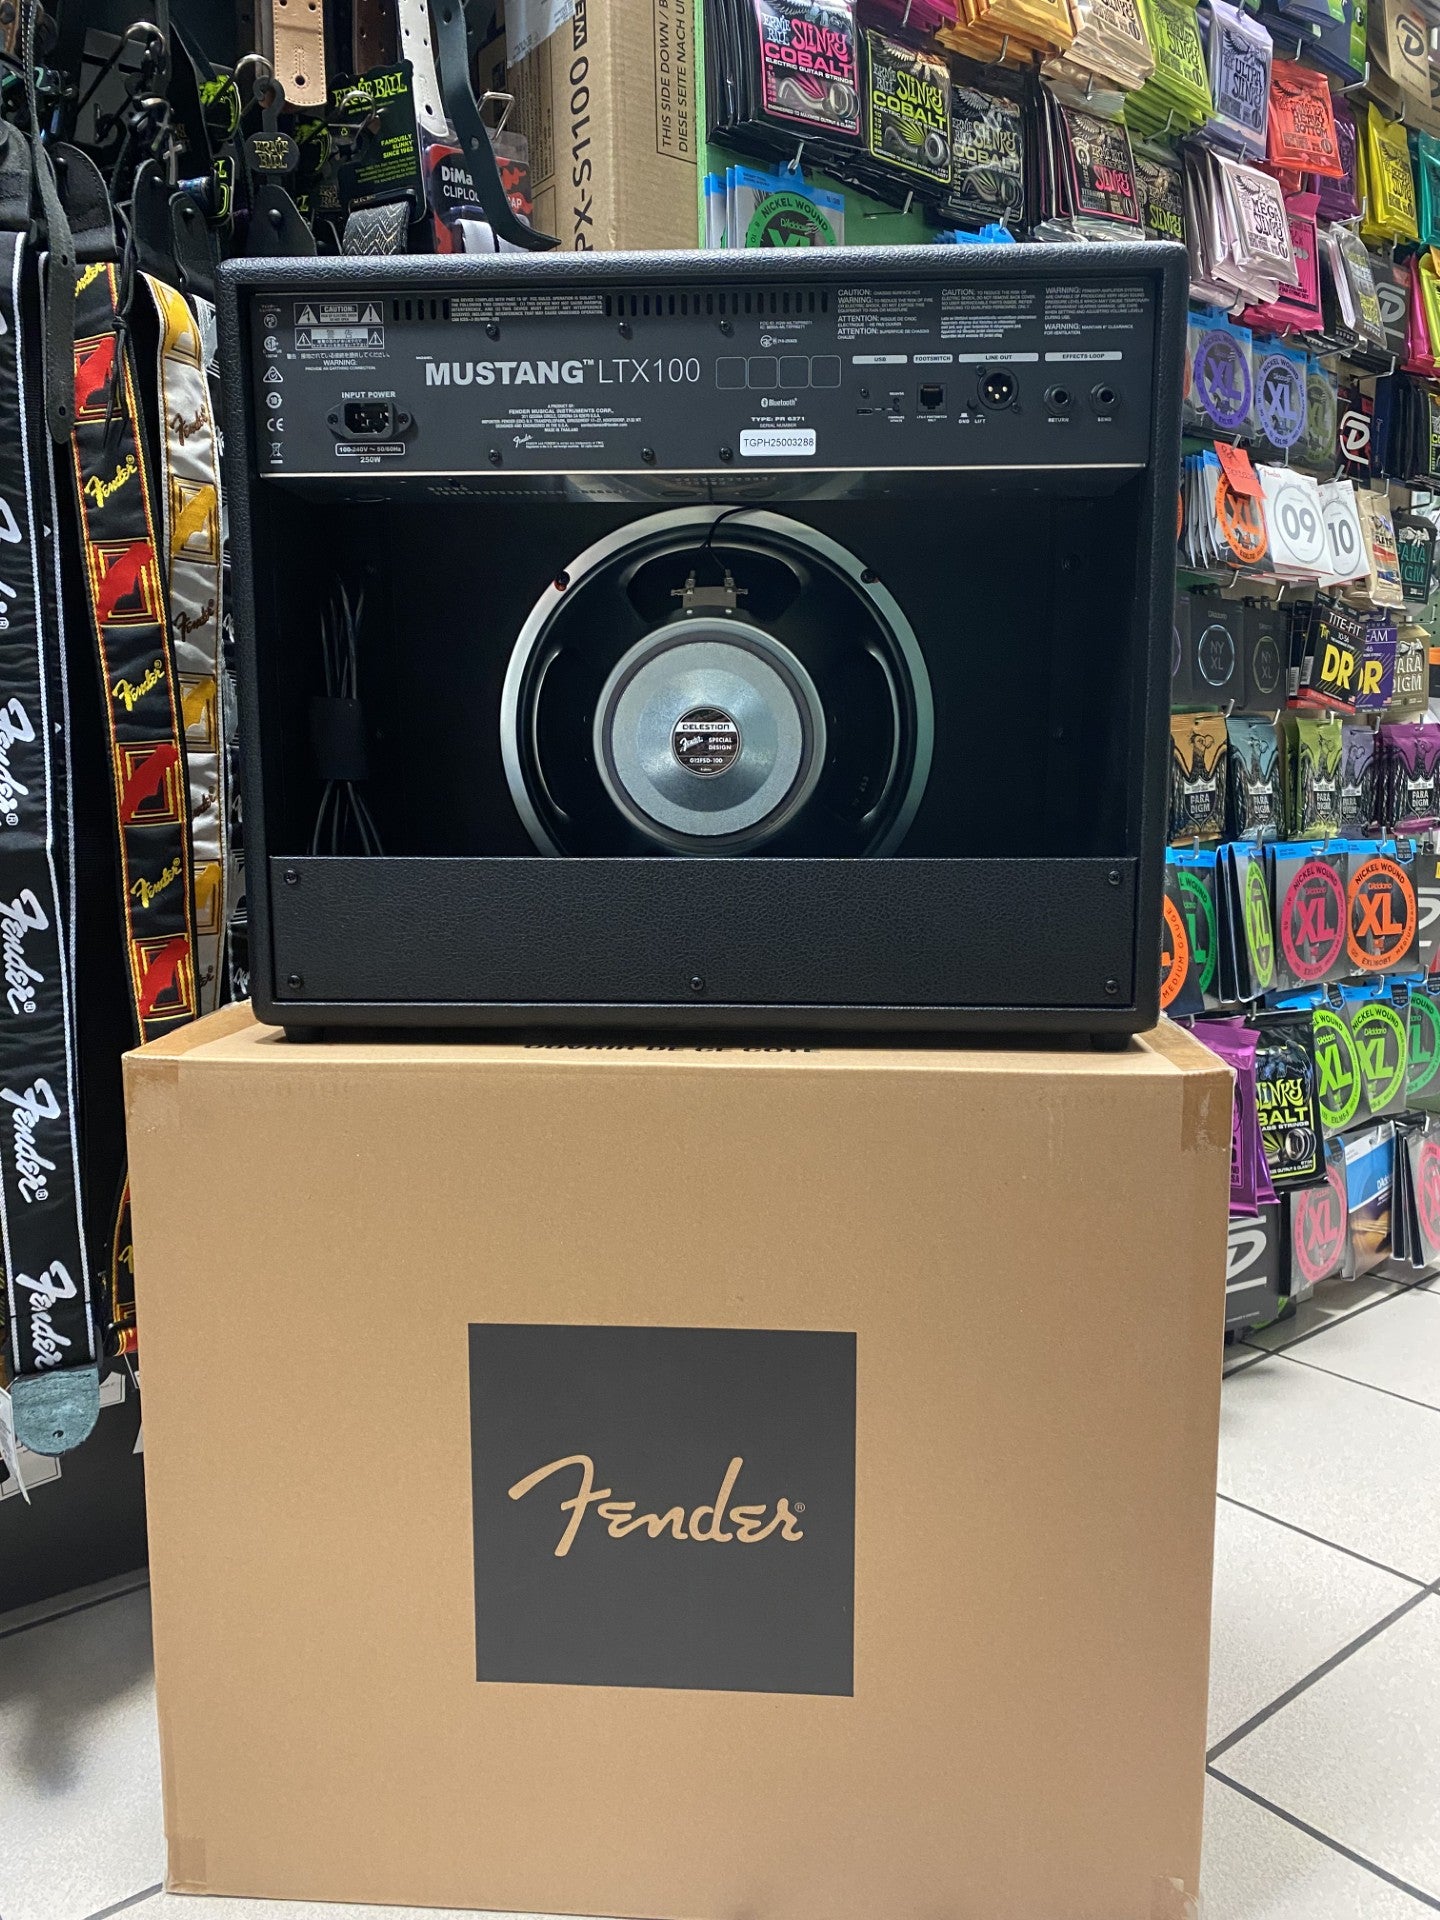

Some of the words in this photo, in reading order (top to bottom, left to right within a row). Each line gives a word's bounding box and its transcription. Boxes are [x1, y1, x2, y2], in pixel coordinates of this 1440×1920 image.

[762, 12, 791, 33] ERNIE
[767, 27, 790, 46] BALL
[659, 22, 670, 74] DOWN
[675, 19, 687, 64] NACH
[790, 18, 848, 62] SLINKY
[764, 42, 853, 78] COBALT
[765, 56, 799, 71] ELECTRIC
[798, 65, 824, 78] GUITAR
[824, 73, 854, 86] STRINGS
[1234, 57, 1262, 88] ULTRA
[374, 72, 408, 98] BALL
[660, 77, 671, 113] SIDE
[676, 66, 688, 106] SEITE
[896, 70, 943, 114] SLINKY
[873, 90, 947, 130] COBALT
[253, 137, 289, 152] ERNIE
[380, 133, 413, 147] FAMOUSLY
[661, 115, 672, 148] THIS
[677, 110, 689, 153] DIESE
[1293, 121, 1329, 138] BOTTOM
[258, 153, 288, 169] BALL
[1092, 164, 1131, 198] SLINKY
[760, 197, 791, 219] NICKEL
[795, 199, 829, 231] WOUND
[1252, 198, 1282, 226] MEGA
[941, 288, 976, 296] CAUTION:
[1045, 286, 1081, 294] WARNING:
[837, 327, 879, 335] ATTENTION:
[598, 357, 700, 383] LTX100
[1207, 356, 1242, 401] XL
[341, 391, 366, 399] INPUT
[367, 391, 396, 399] POWER
[1266, 380, 1298, 420] XL
[360, 456, 381, 464] 250W
[1281, 503, 1316, 544] 09
[1328, 519, 1354, 557] 10
[1328, 612, 1362, 637] TITE-FIT
[1210, 640, 1225, 655] NY
[1211, 656, 1224, 671] XL
[1320, 643, 1354, 690] DR
[1411, 797, 1429, 807] DIGM
[1412, 789, 1429, 799] PARA
[1293, 867, 1315, 890] NICKEL
[1315, 866, 1338, 887] WOUND
[1355, 864, 1380, 885] NICKEL
[1380, 862, 1405, 884] WOUND
[1185, 875, 1209, 903] WOUND
[1166, 906, 1185, 950] GAUGE
[1251, 899, 1270, 949] XL
[1295, 897, 1335, 946] XL
[1356, 892, 1403, 937] XL
[1162, 955, 1184, 1000] MEDIUM
[1319, 1014, 1343, 1031] WOUND
[1352, 1008, 1375, 1030] NICKEL
[1375, 1007, 1399, 1028] WOUND
[1315, 1043, 1353, 1098] XL
[1356, 1037, 1394, 1080] XL
[1258, 1106, 1309, 1126] BALT
[1278, 1120, 1310, 1129] STRINGS
[1308, 1198, 1339, 1251] XL
[15, 1260, 78, 1369] Fender
